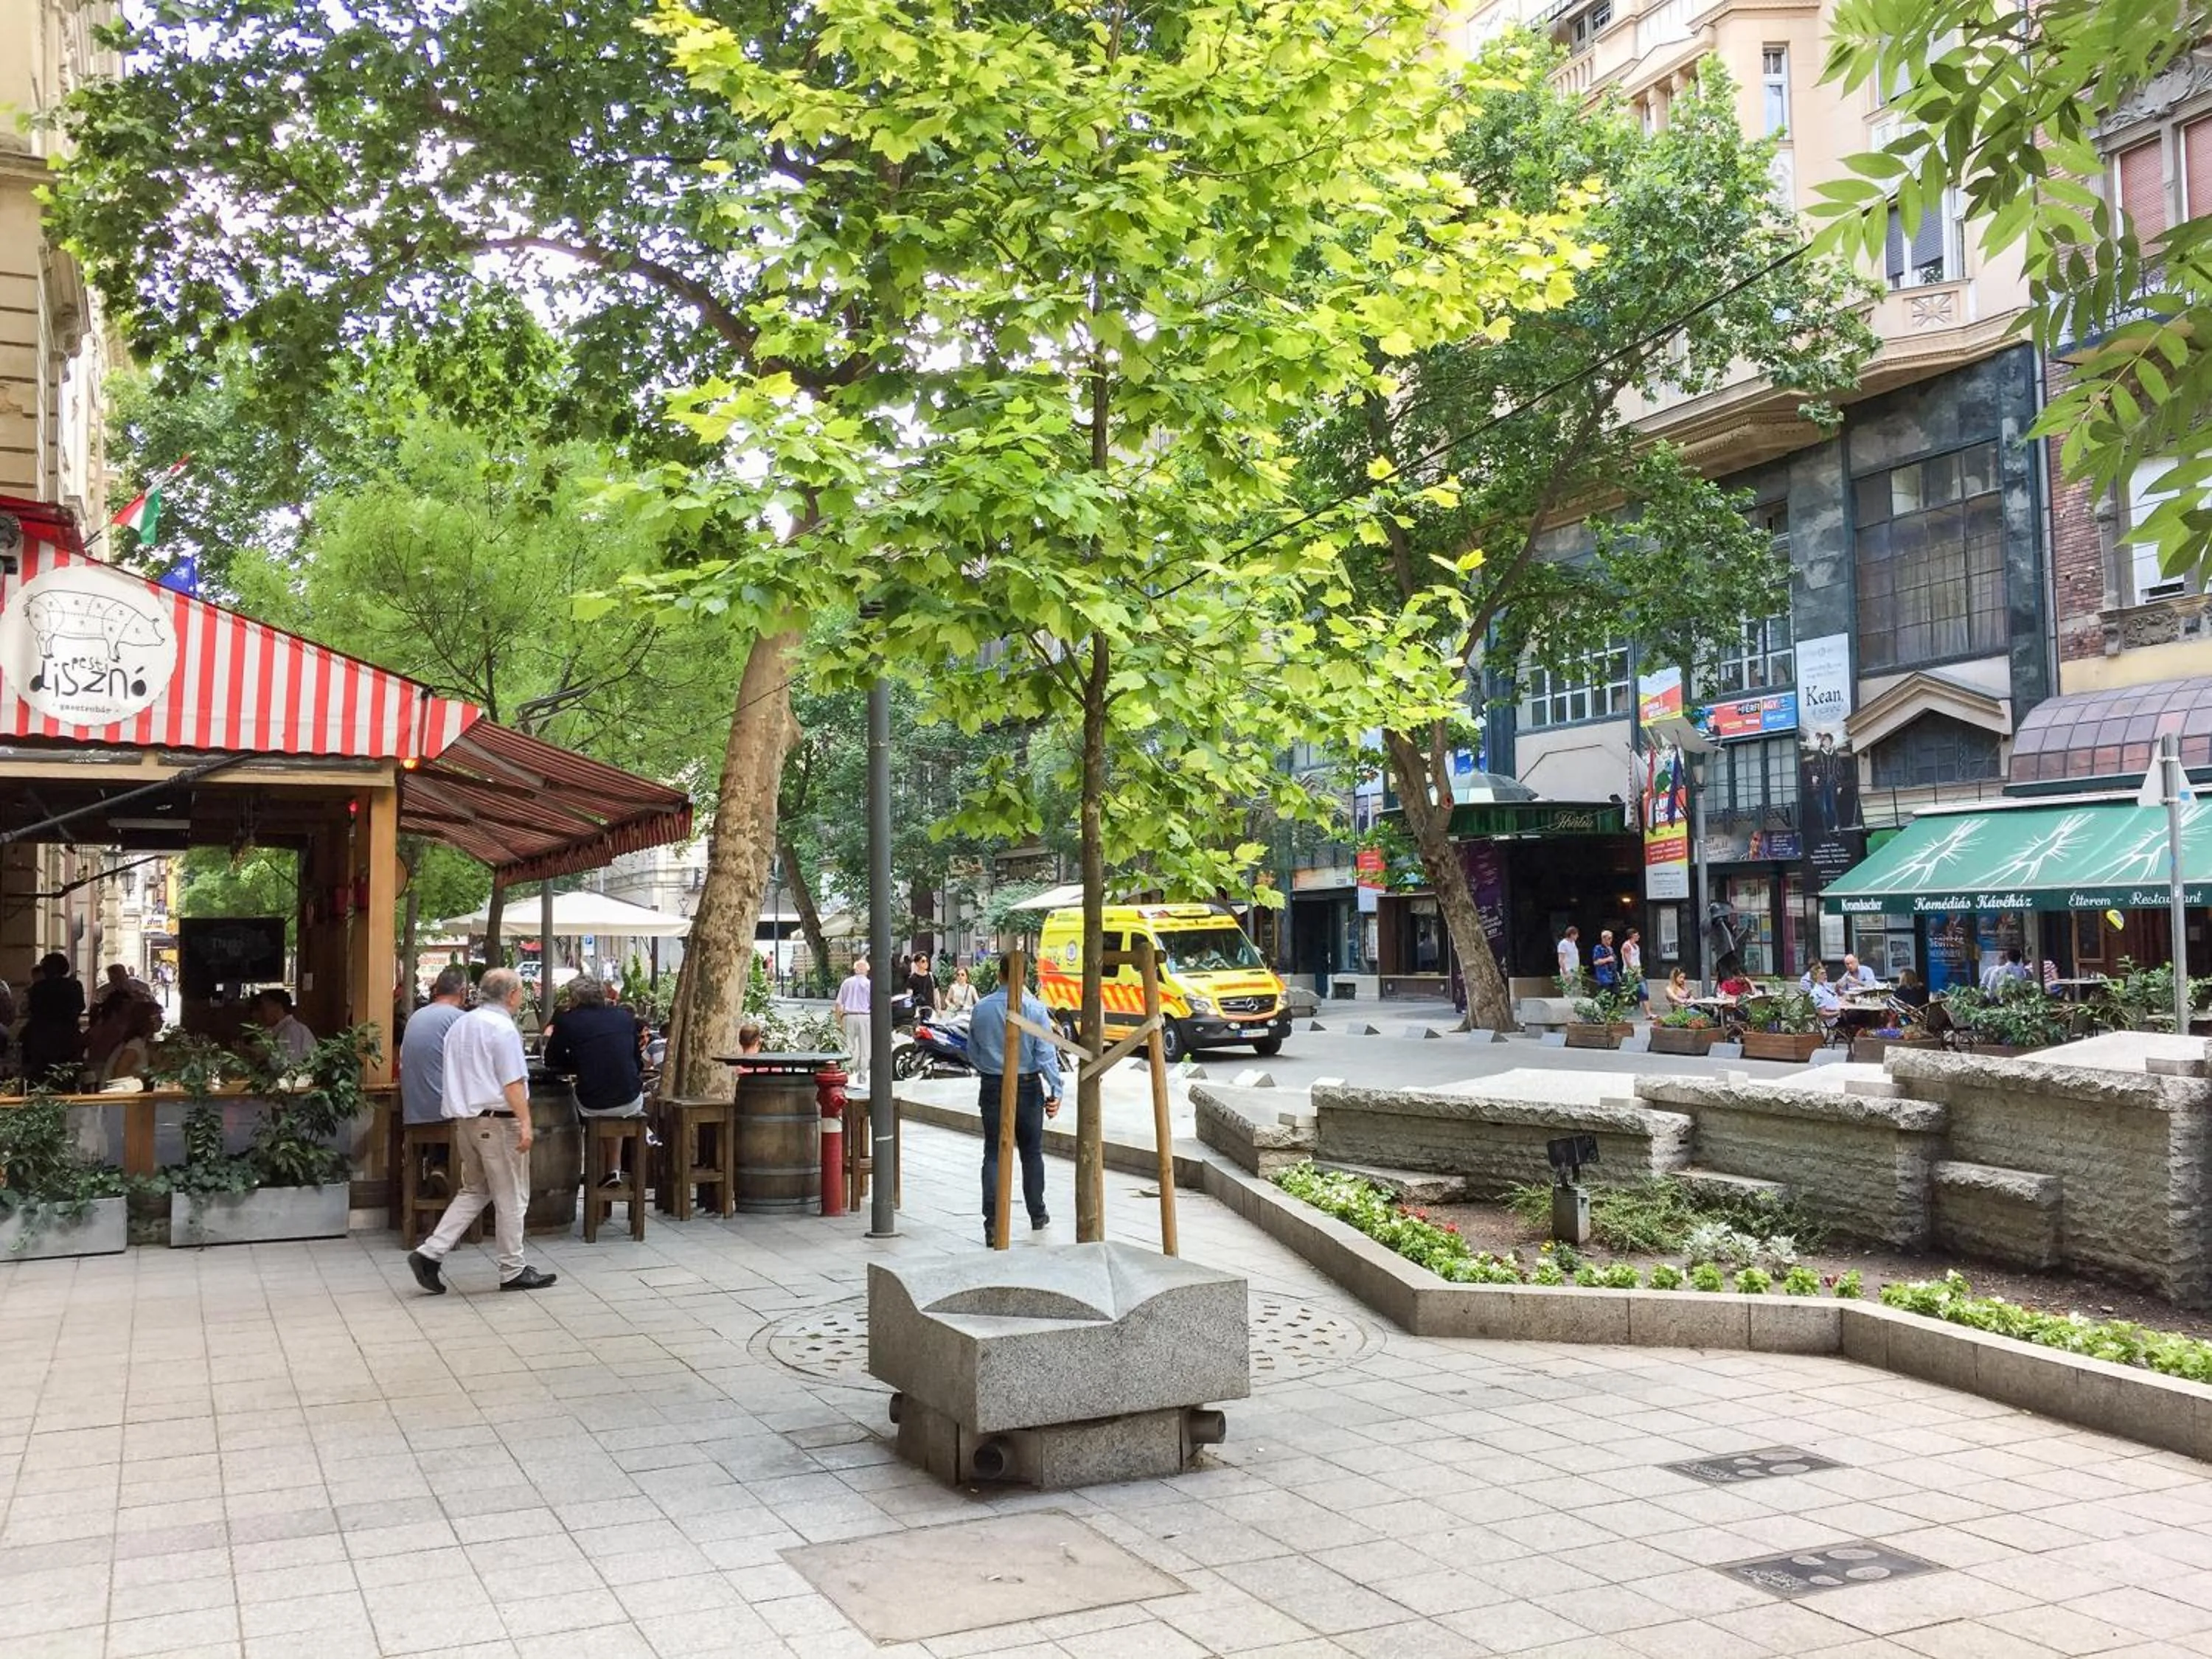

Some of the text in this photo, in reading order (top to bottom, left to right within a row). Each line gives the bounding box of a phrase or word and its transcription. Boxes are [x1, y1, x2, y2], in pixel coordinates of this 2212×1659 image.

[72, 656, 108, 672] pesti
[29, 660, 147, 699] disznó
[1913, 894, 2032, 911] Komédiás Kávéház
[2068, 891, 2112, 906] Étterem
[2129, 891, 2202, 905] Restauant
